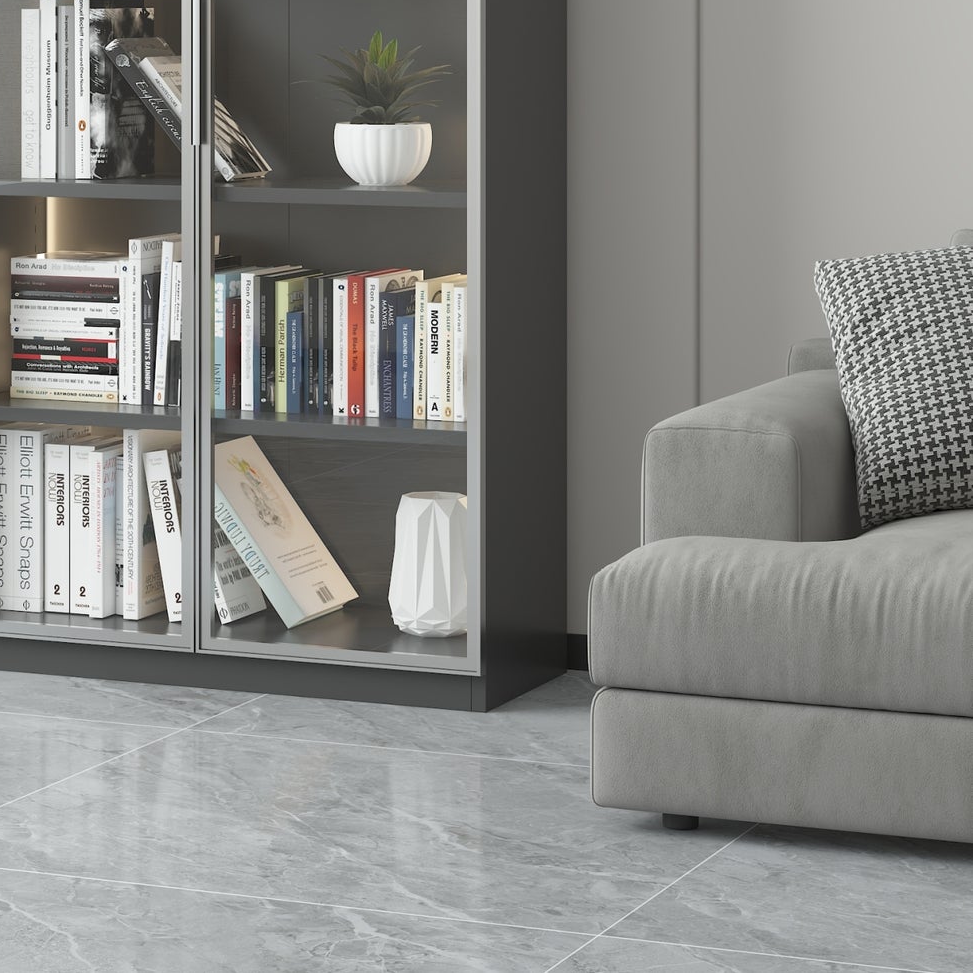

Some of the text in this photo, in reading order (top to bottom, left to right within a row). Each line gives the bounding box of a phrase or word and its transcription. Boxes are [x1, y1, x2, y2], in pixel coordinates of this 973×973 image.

[136, 80, 170, 115] English
[383, 360, 391, 413] ENCHANTRESS
[431, 402, 438, 411] A
[48, 472, 56, 502] NOW!
[17, 436, 34, 590] Elliott Erwitt Snaps
[159, 479, 175, 533] INTERIORS
[54, 584, 60, 595] 2
[80, 586, 86, 597] 2
